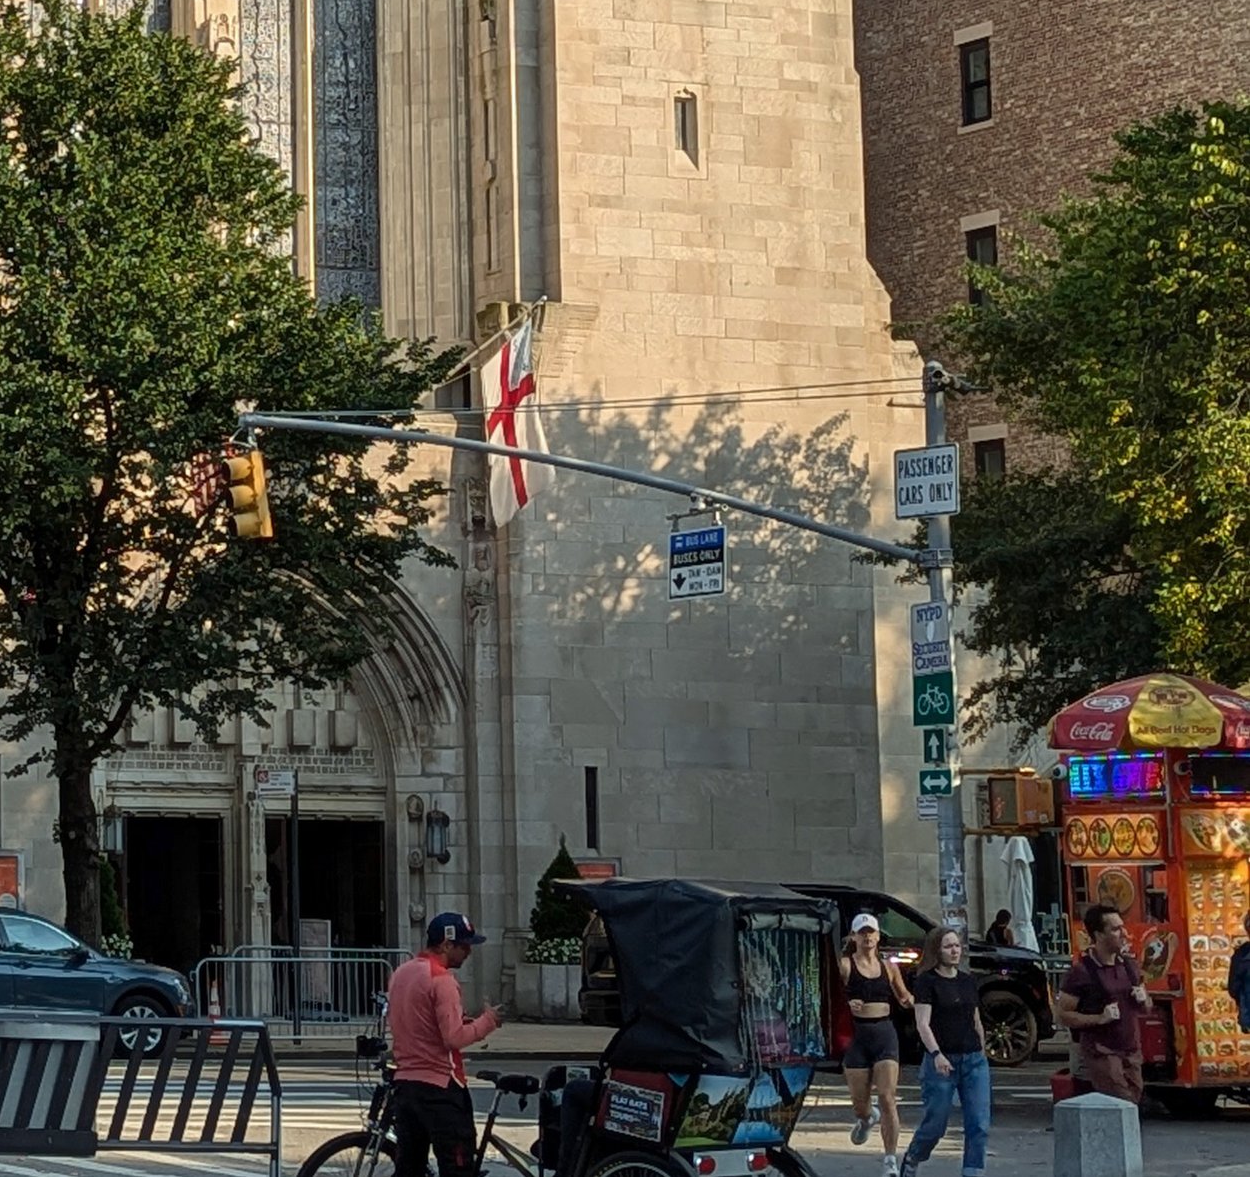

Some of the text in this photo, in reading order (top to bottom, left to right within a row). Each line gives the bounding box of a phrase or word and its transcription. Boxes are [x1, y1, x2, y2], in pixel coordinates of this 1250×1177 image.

[898, 454, 953, 479] PASSENGER
[899, 481, 953, 506] CARS ONLY
[685, 532, 718, 547] BUS LANE
[673, 549, 721, 566] BUSES ONLY
[916, 606, 942, 623] NYPD
[1070, 722, 1116, 741] Coca-Cola
[1136, 725, 1217, 736] All Beef Hot Dogs
